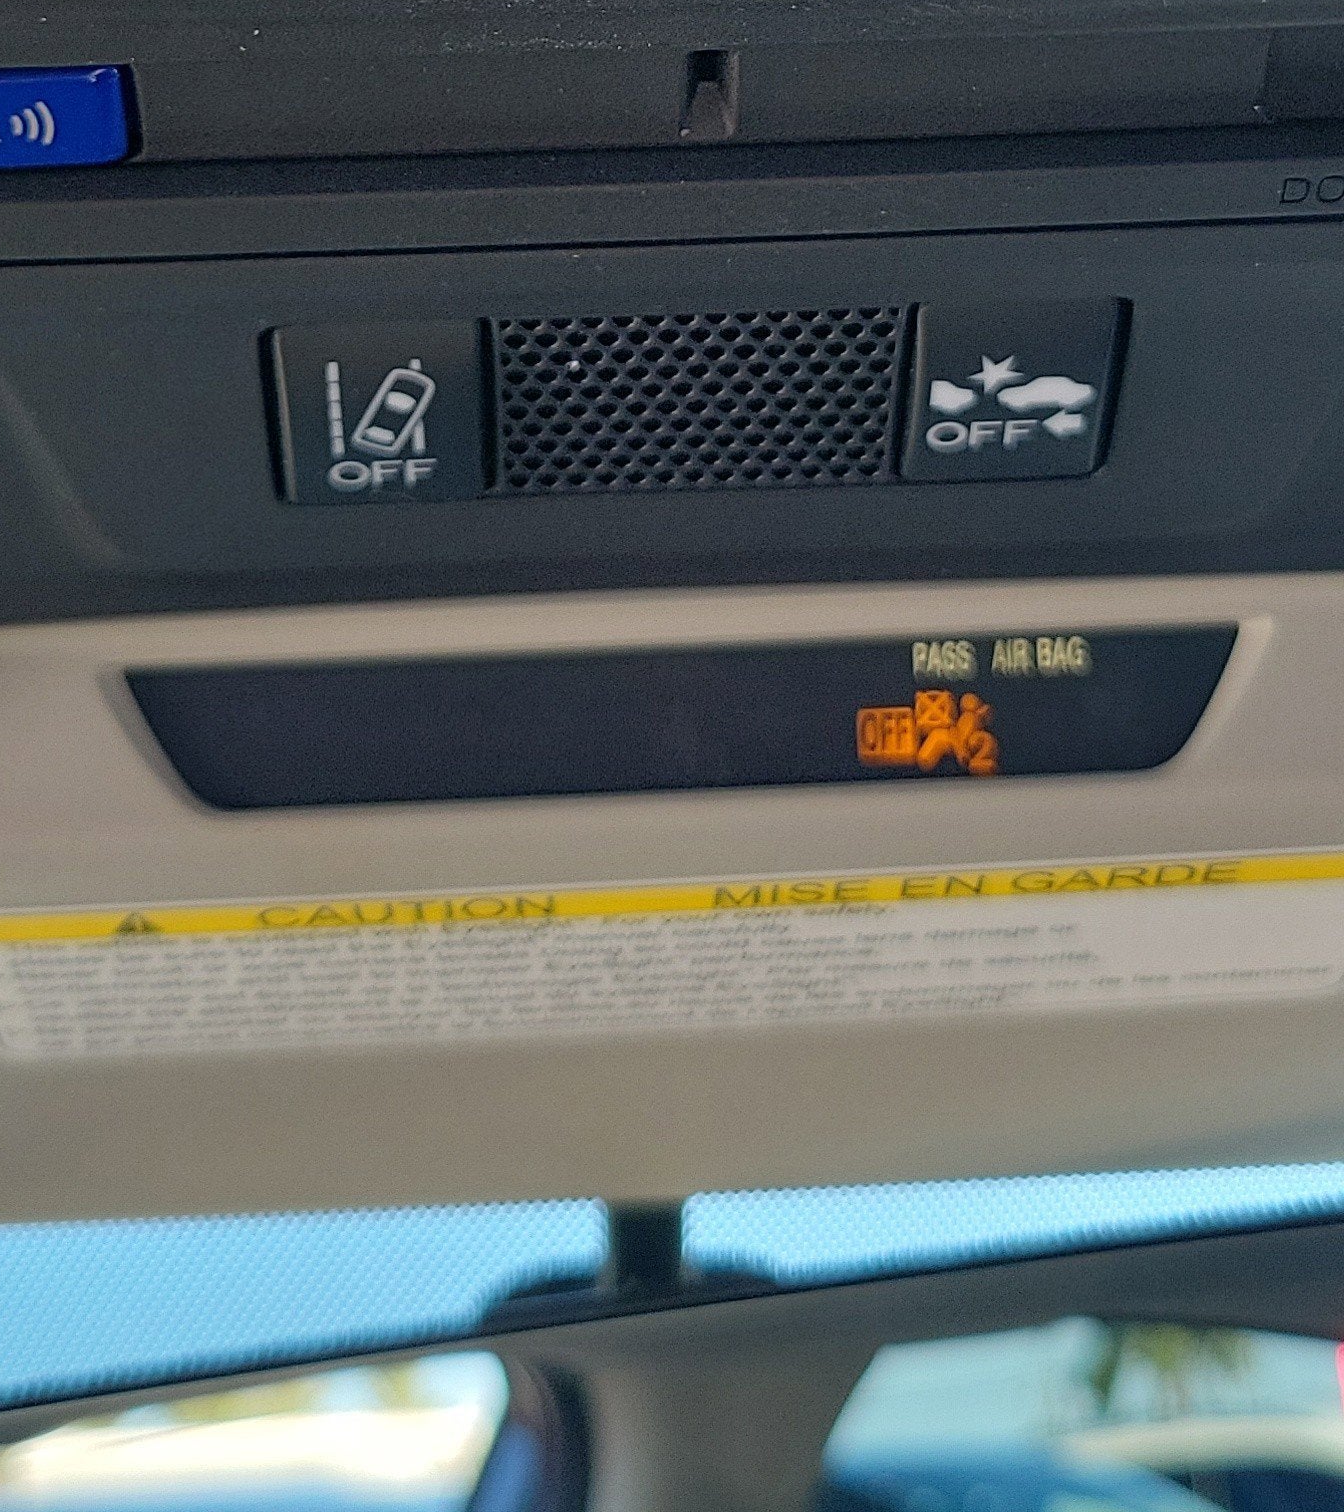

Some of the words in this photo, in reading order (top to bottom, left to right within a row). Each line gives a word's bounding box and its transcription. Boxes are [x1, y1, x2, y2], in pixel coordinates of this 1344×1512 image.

[925, 419, 1039, 453] OFF
[328, 457, 438, 492] OFF
[911, 640, 977, 681] PASS
[990, 638, 1035, 677] AIR
[1035, 635, 1093, 676] BAG
[861, 710, 914, 756] OFF
[710, 876, 869, 908] MISE
[897, 872, 986, 899] EN
[1010, 861, 1244, 893] GARDE
[256, 894, 555, 928] CAUTION
